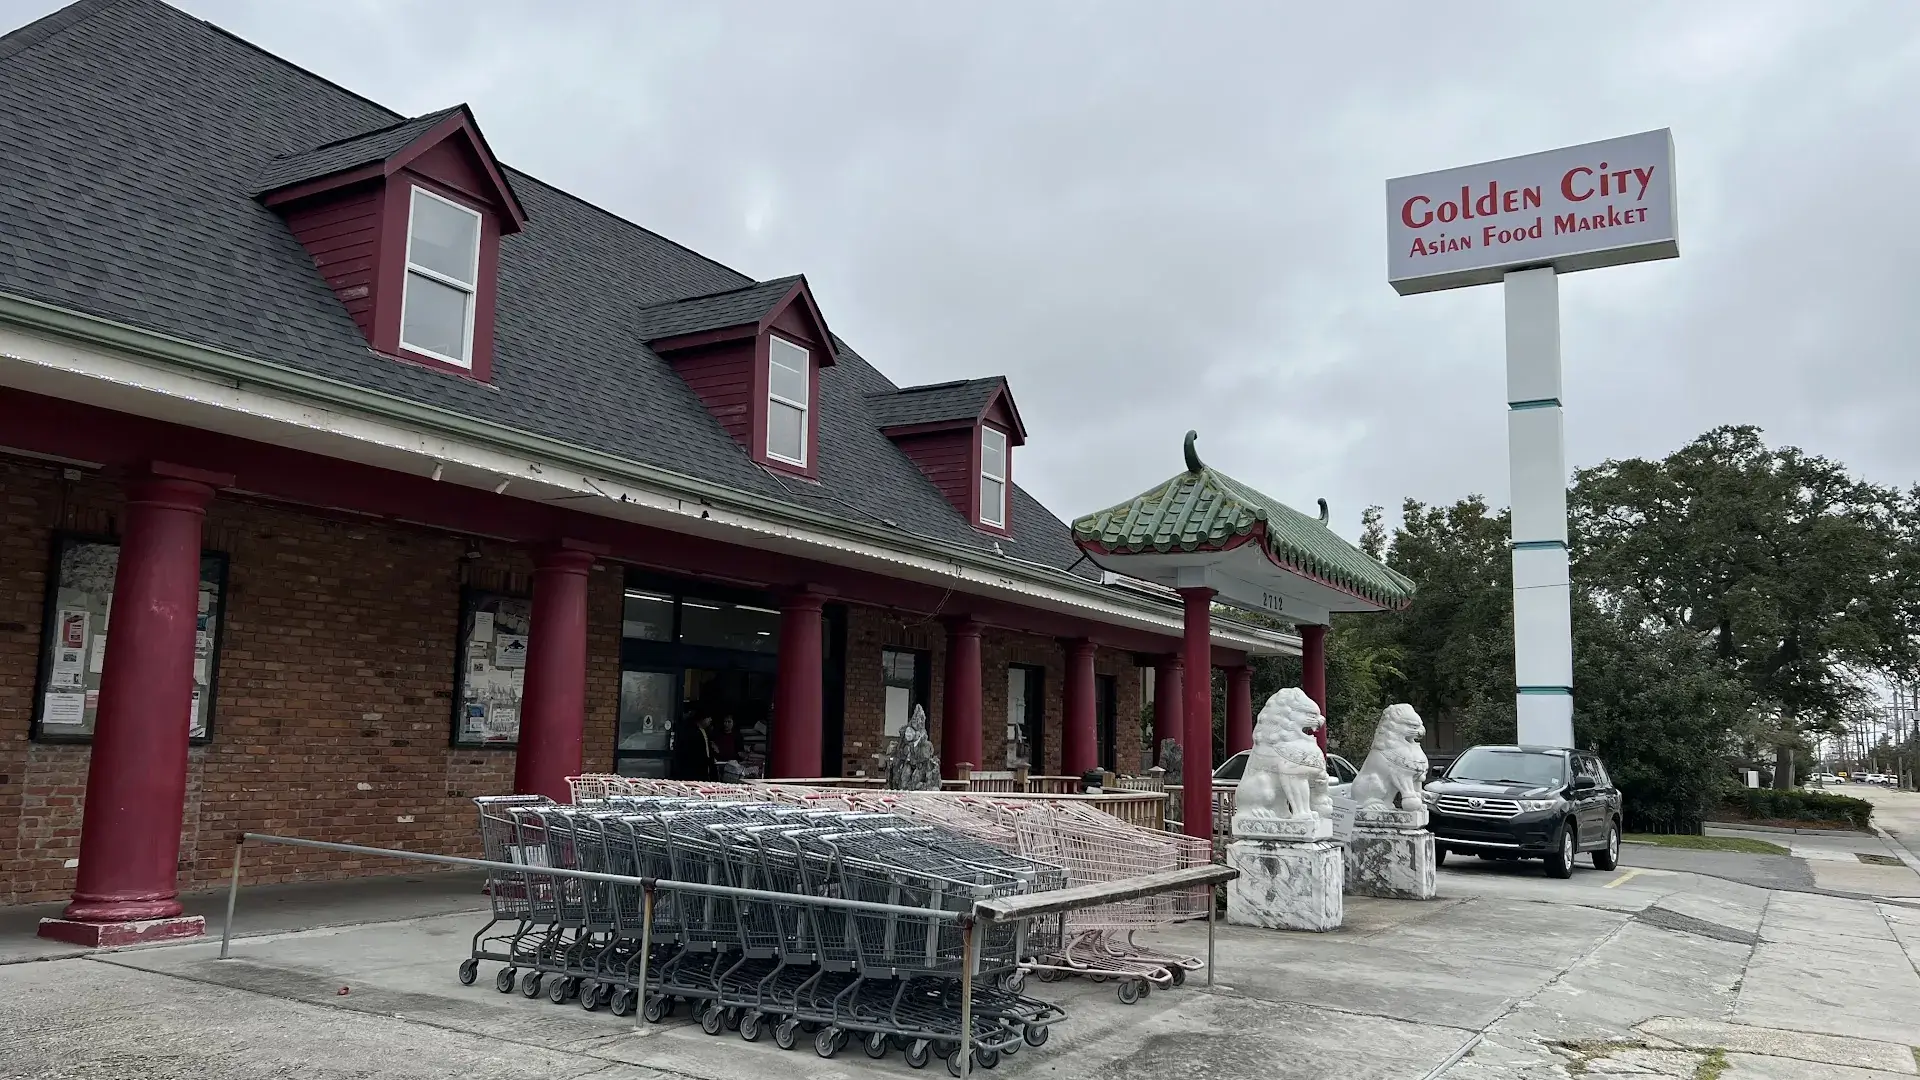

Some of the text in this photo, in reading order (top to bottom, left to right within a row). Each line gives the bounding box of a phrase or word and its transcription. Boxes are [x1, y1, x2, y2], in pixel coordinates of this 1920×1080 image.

[1401, 161, 1655, 229] Golden City
[1409, 205, 1648, 258] Asian Food Market
[1262, 591, 1283, 611] 2712
